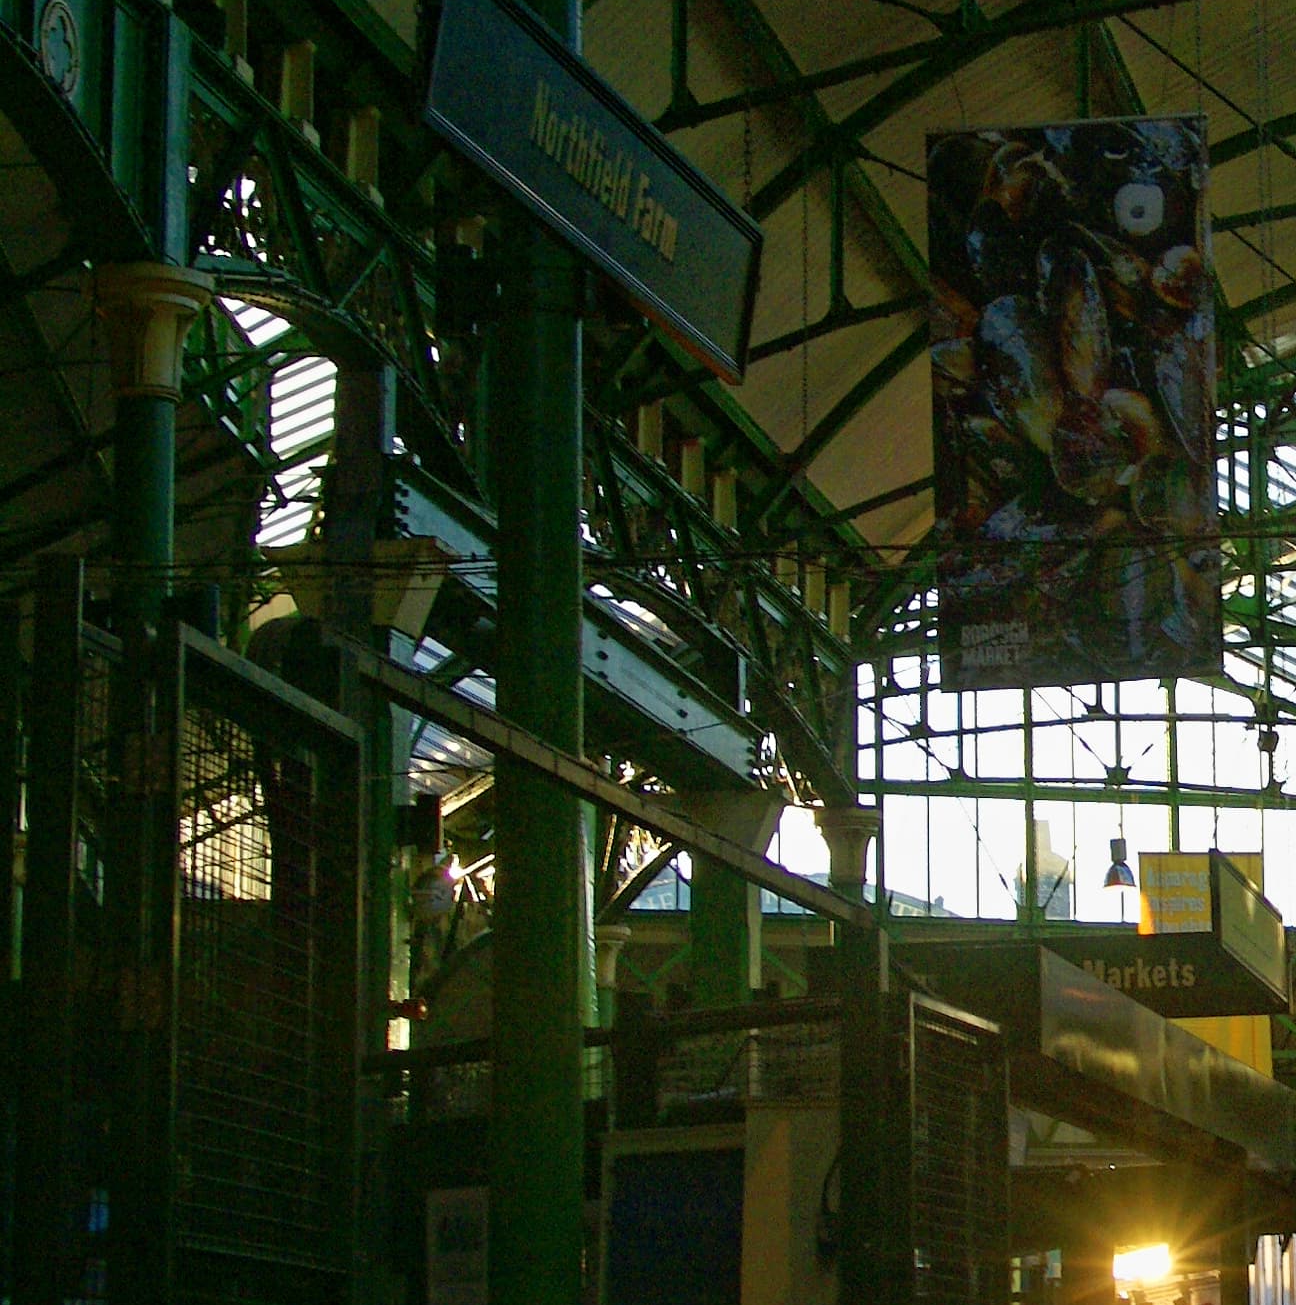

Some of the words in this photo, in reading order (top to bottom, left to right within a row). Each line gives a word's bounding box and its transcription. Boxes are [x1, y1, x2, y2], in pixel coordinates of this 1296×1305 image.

[530, 79, 636, 221] Northfield
[634, 172, 678, 262] Farm
[1083, 957, 1196, 989] Markets
